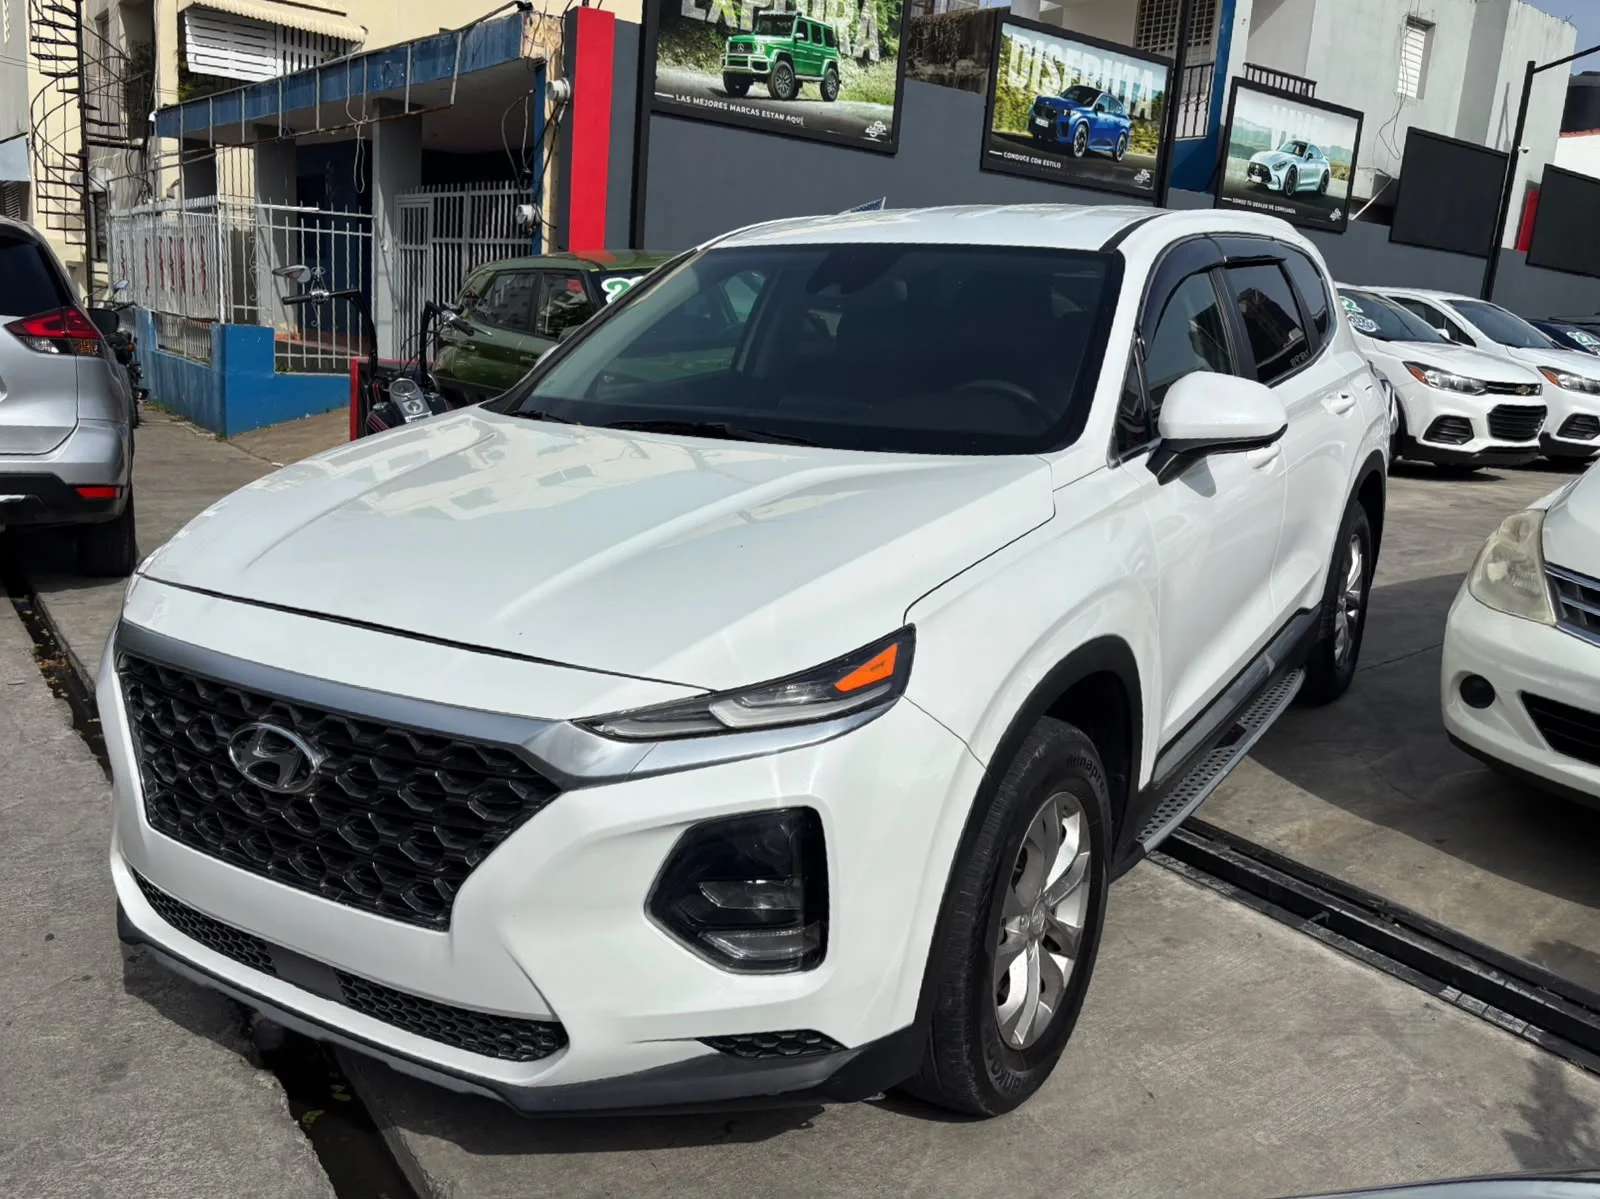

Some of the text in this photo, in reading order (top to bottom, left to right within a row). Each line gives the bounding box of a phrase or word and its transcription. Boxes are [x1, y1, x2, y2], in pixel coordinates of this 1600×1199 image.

[675, 94, 691, 104] LAS
[693, 96, 728, 110] MEJORES
[730, 104, 760, 117] MARCAS
[761, 110, 785, 121] ESTAN
[1003, 151, 1061, 169] CONDUCE CON ESTILO
